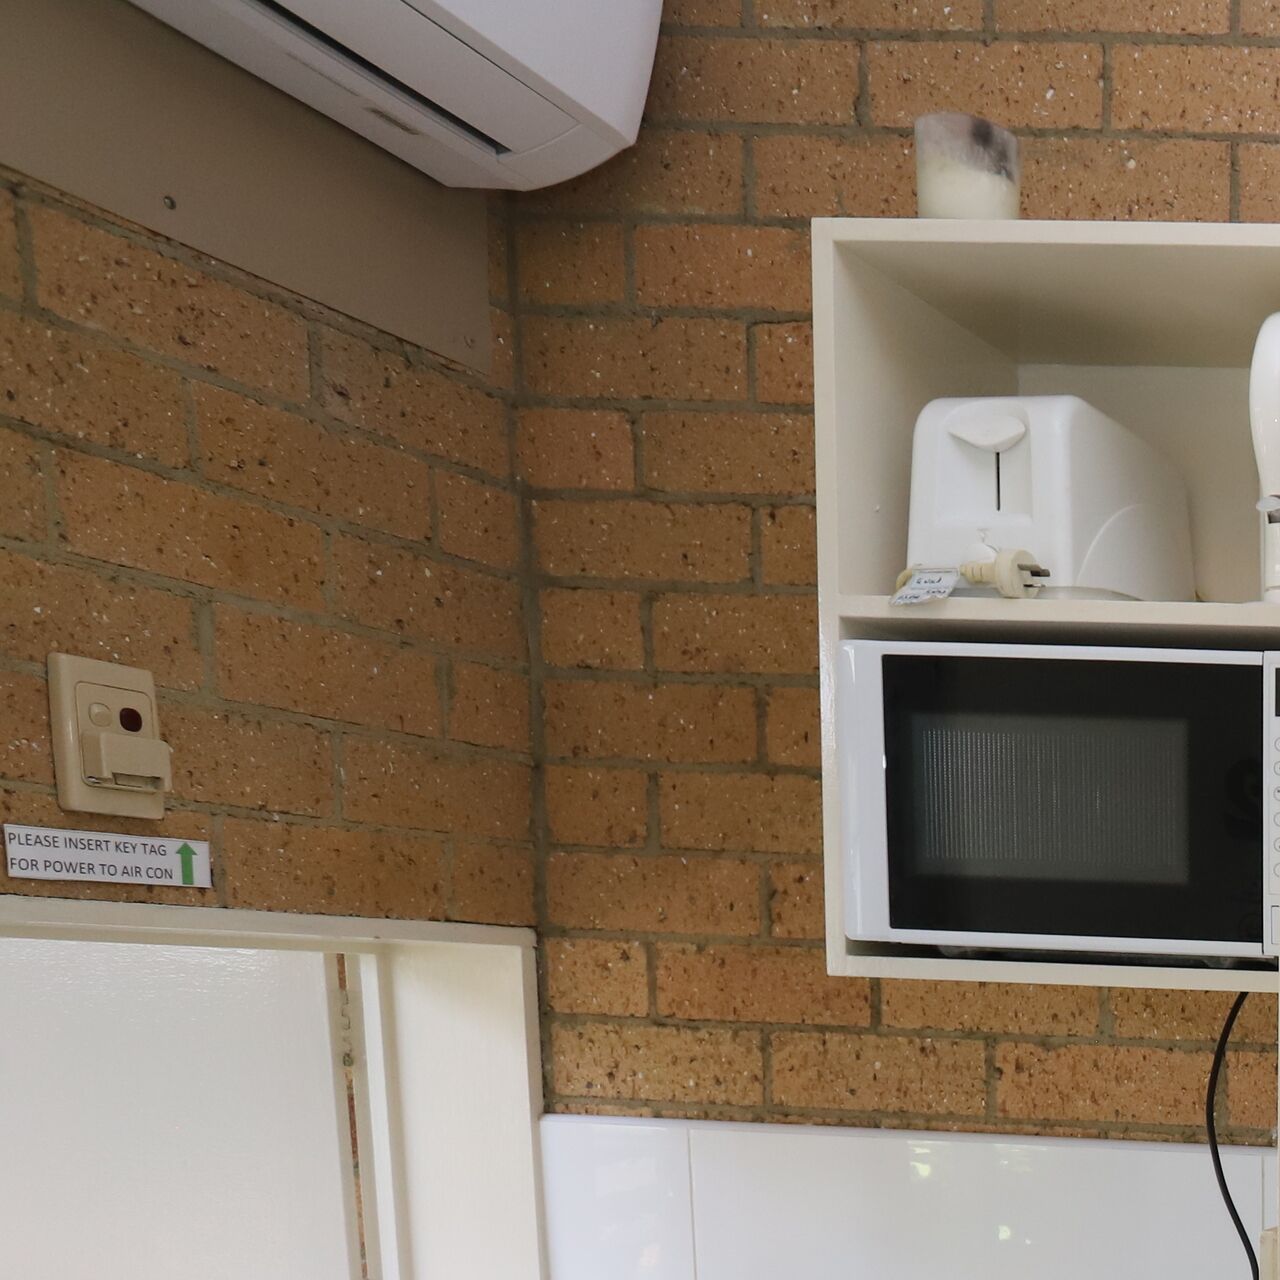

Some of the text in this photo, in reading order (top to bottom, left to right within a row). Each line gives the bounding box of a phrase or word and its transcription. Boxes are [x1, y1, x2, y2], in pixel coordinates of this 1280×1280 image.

[8, 831, 168, 857] PLEASE INSERT KEY TAG
[10, 857, 174, 880] FOR POWER TO AIR CON
